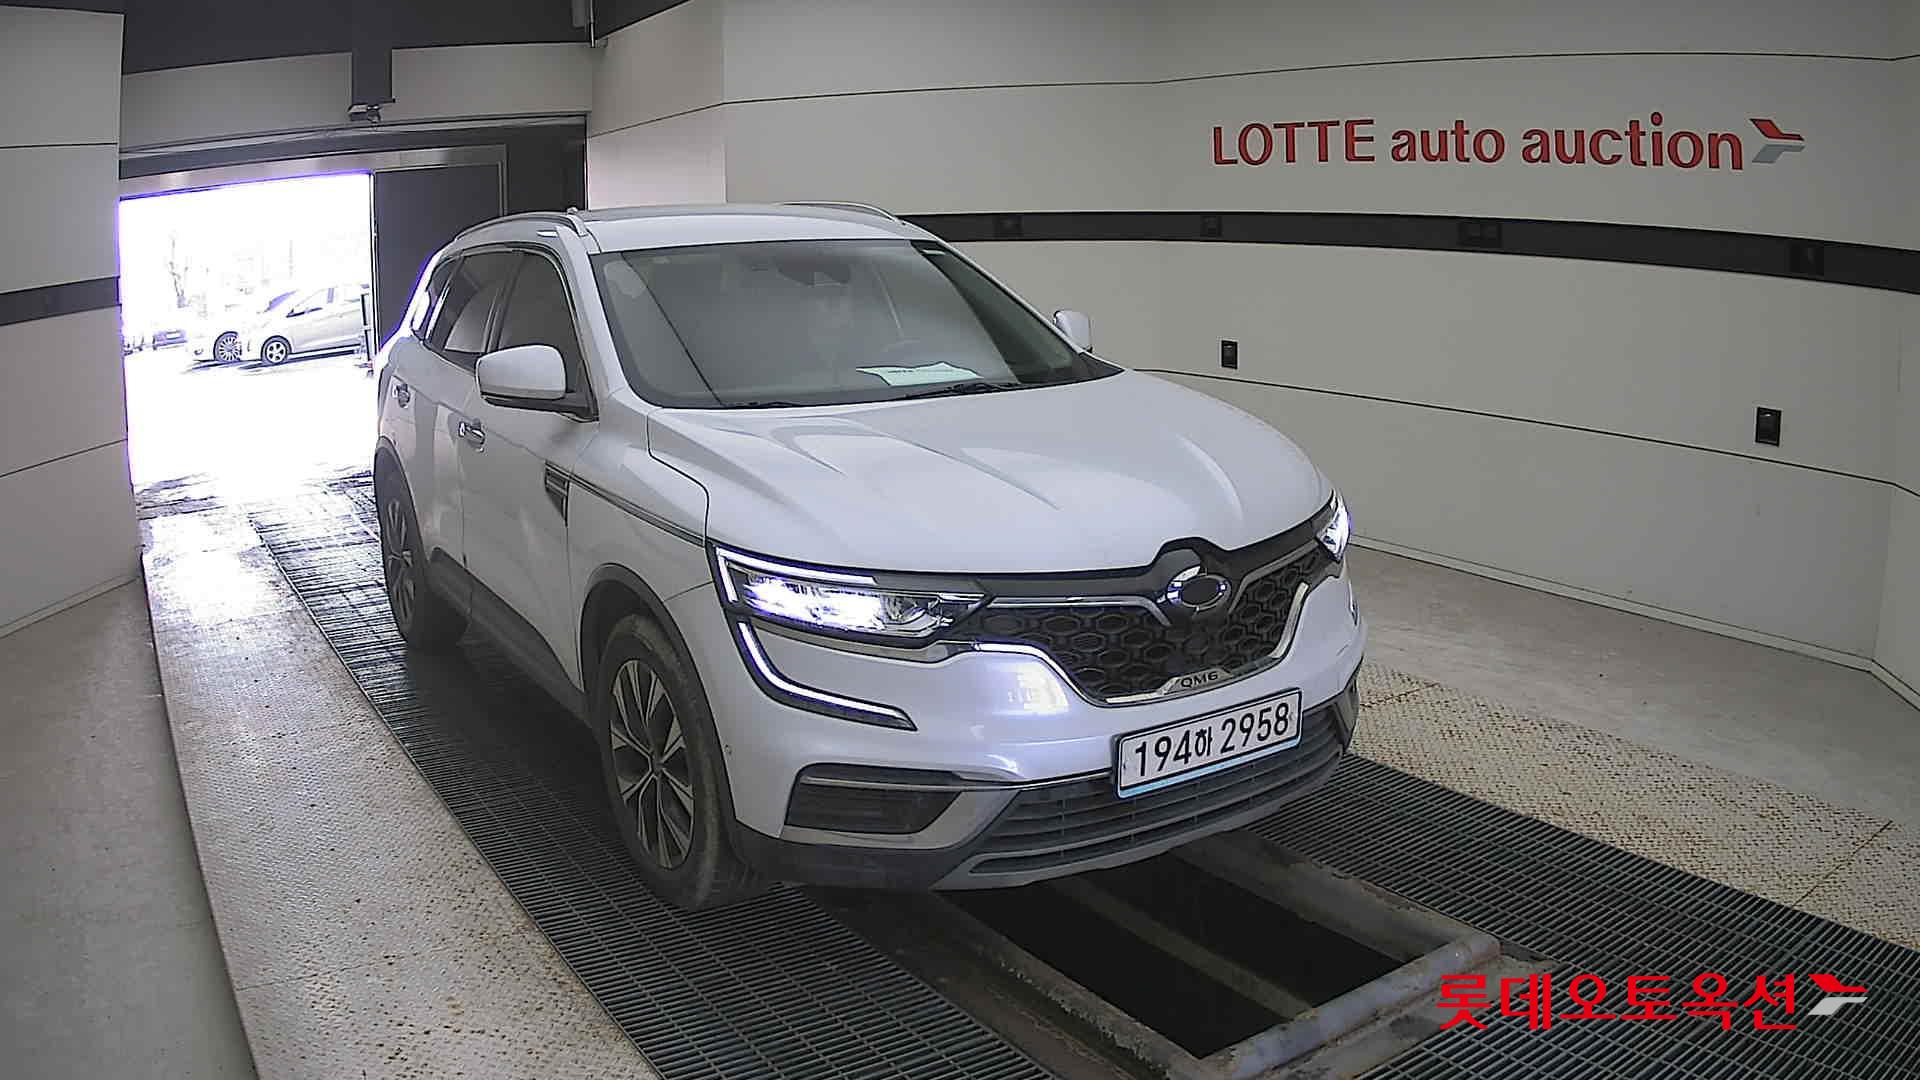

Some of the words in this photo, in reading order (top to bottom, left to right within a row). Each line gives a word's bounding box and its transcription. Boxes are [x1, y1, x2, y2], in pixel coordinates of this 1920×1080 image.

[1212, 117, 1376, 167] LOTTE
[1390, 119, 1505, 164] auto
[1521, 111, 1745, 170] auction
[1181, 671, 1219, 688] QM6
[1135, 726, 1213, 777] 194하
[1220, 702, 1290, 754] 2958
